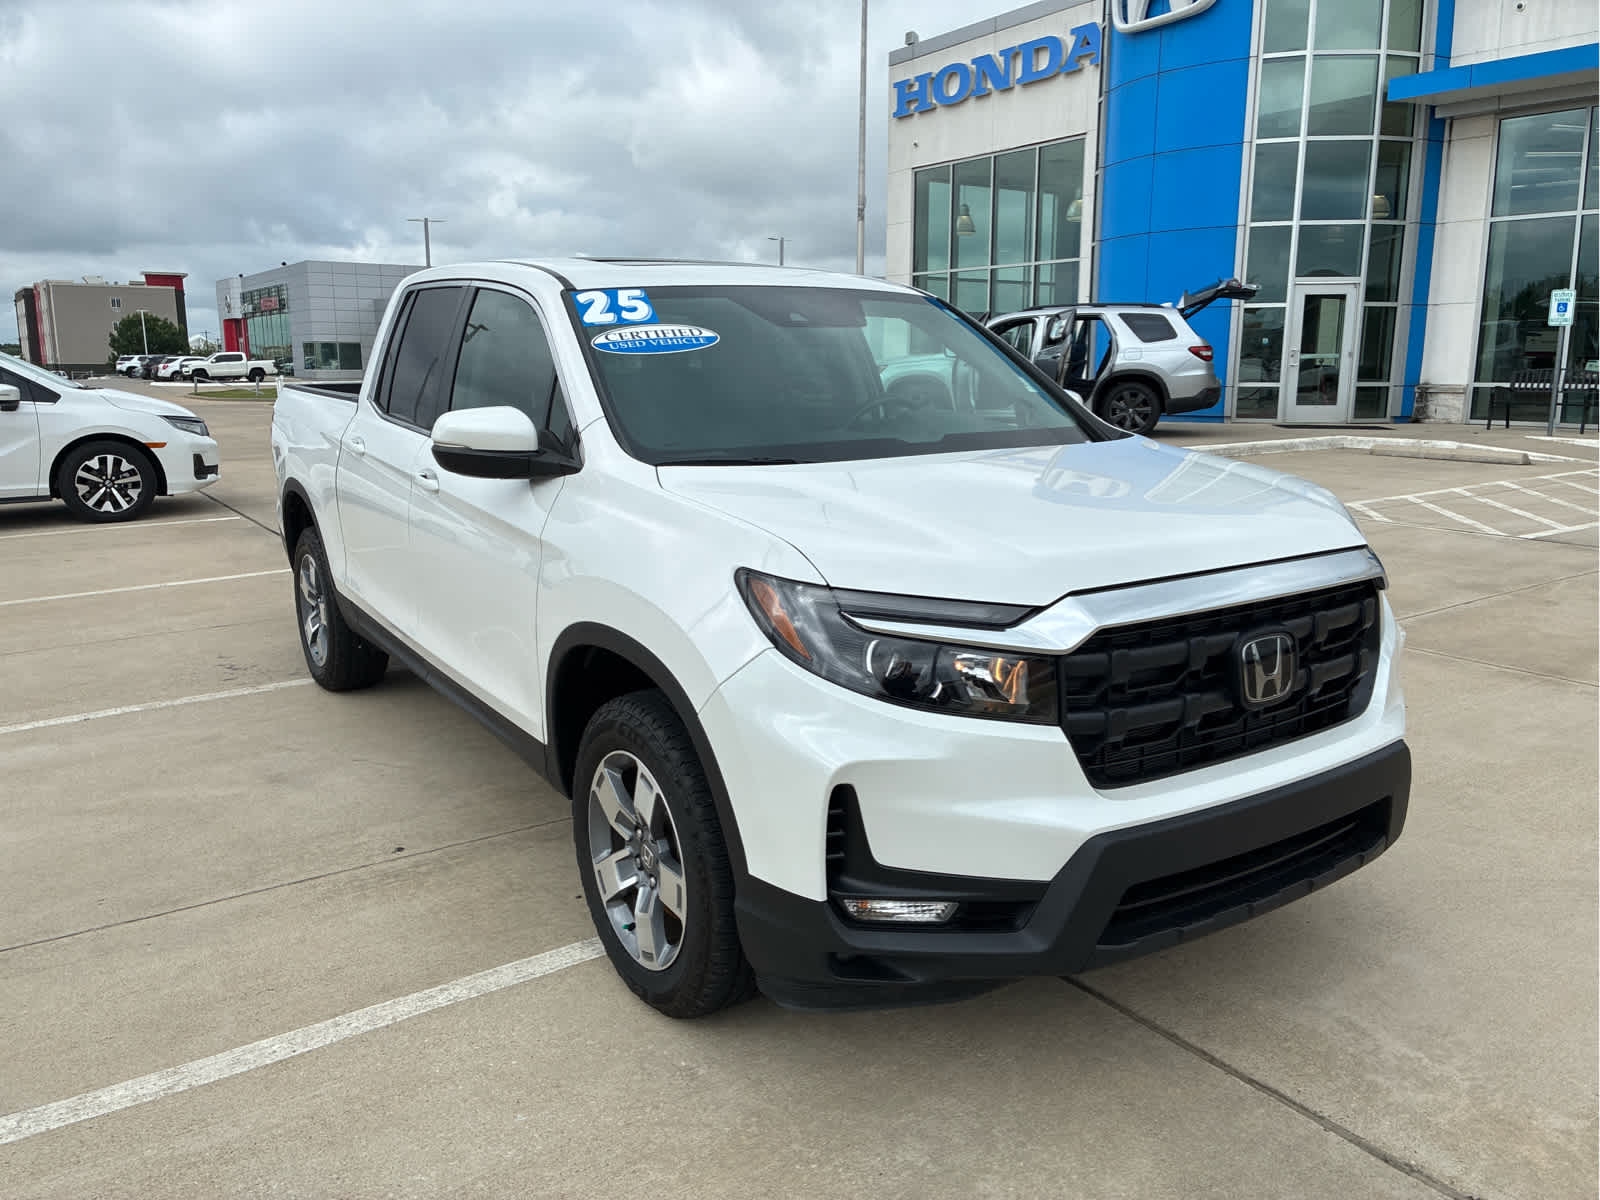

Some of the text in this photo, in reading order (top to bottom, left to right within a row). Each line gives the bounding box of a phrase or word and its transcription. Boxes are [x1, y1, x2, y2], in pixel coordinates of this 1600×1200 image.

[892, 22, 1100, 118] HONDA
[576, 289, 653, 325] 25
[604, 328, 704, 341] CERTIFIED
[609, 336, 707, 350] USED VEHICLE
